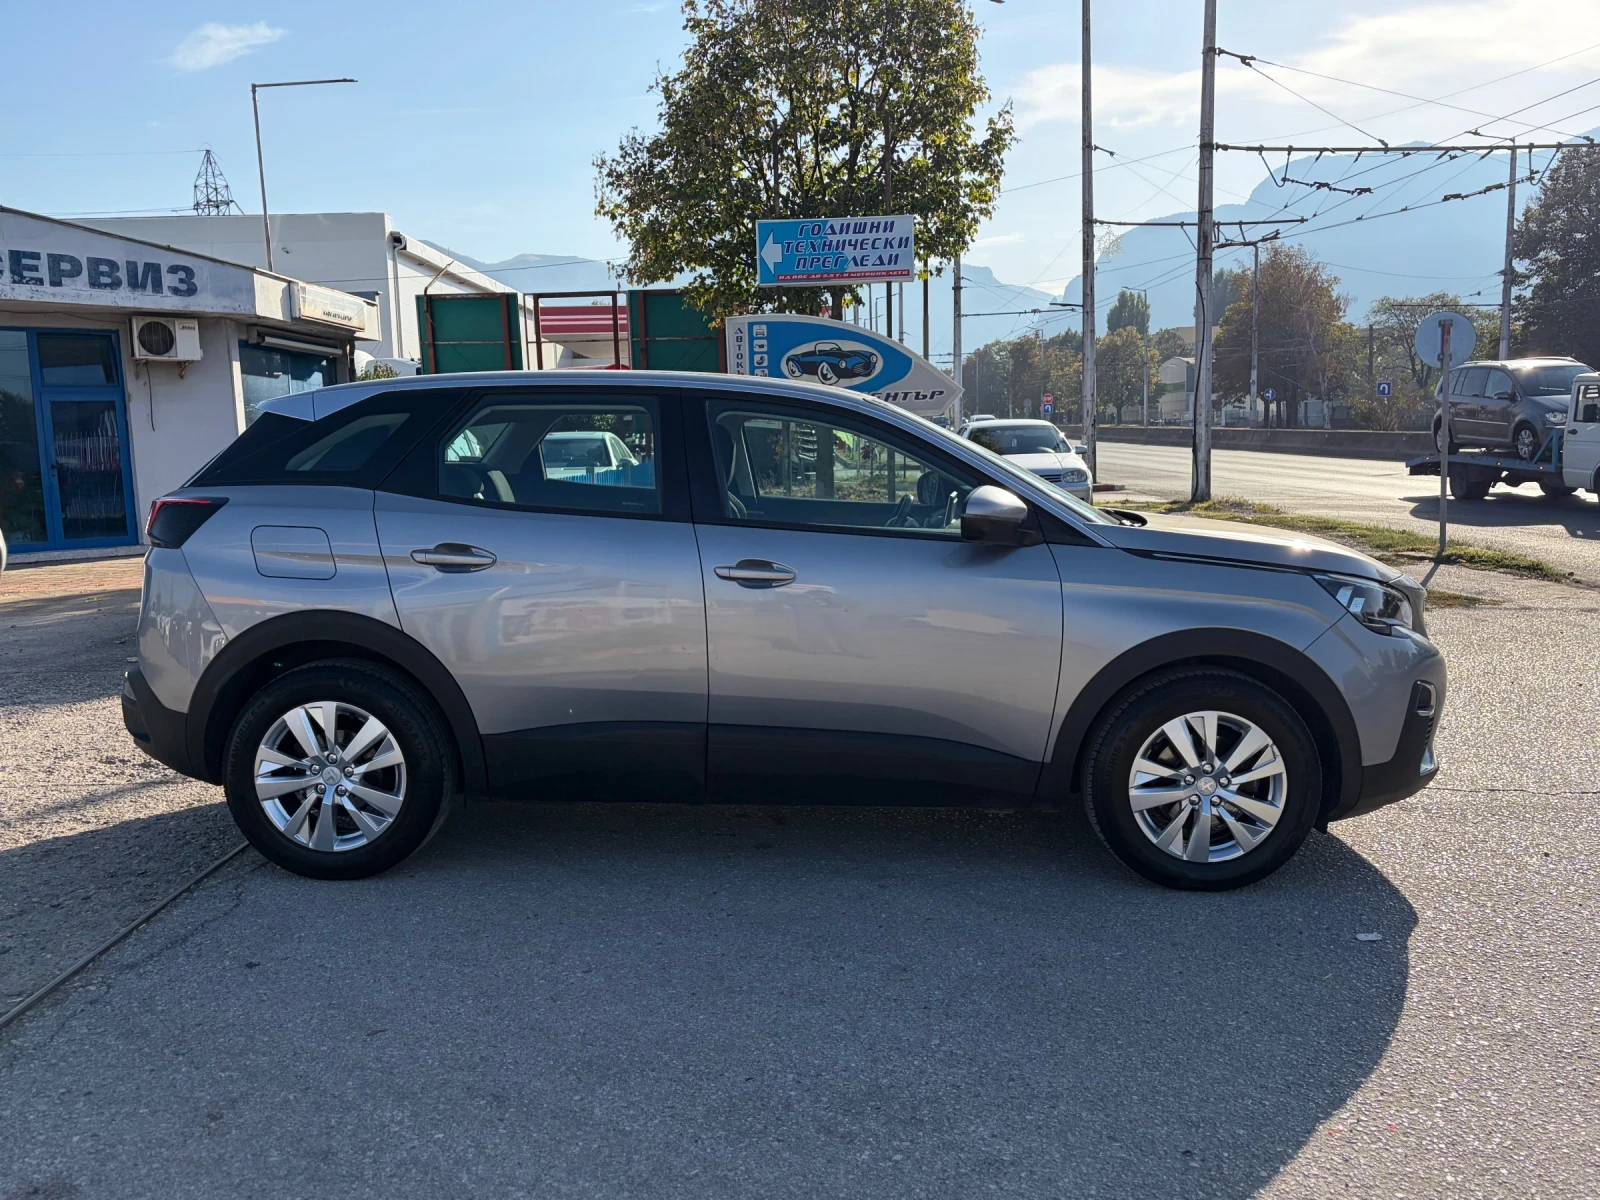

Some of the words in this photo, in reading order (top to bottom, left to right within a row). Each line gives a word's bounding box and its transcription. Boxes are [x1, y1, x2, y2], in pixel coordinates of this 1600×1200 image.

[798, 220, 895, 237] ГОДИШНИ
[783, 236, 910, 254] ТЕХНИЧЕСКИ
[795, 253, 900, 270] ПРЕГЛЕДИ
[0, 249, 198, 297] ЕРВИЗ
